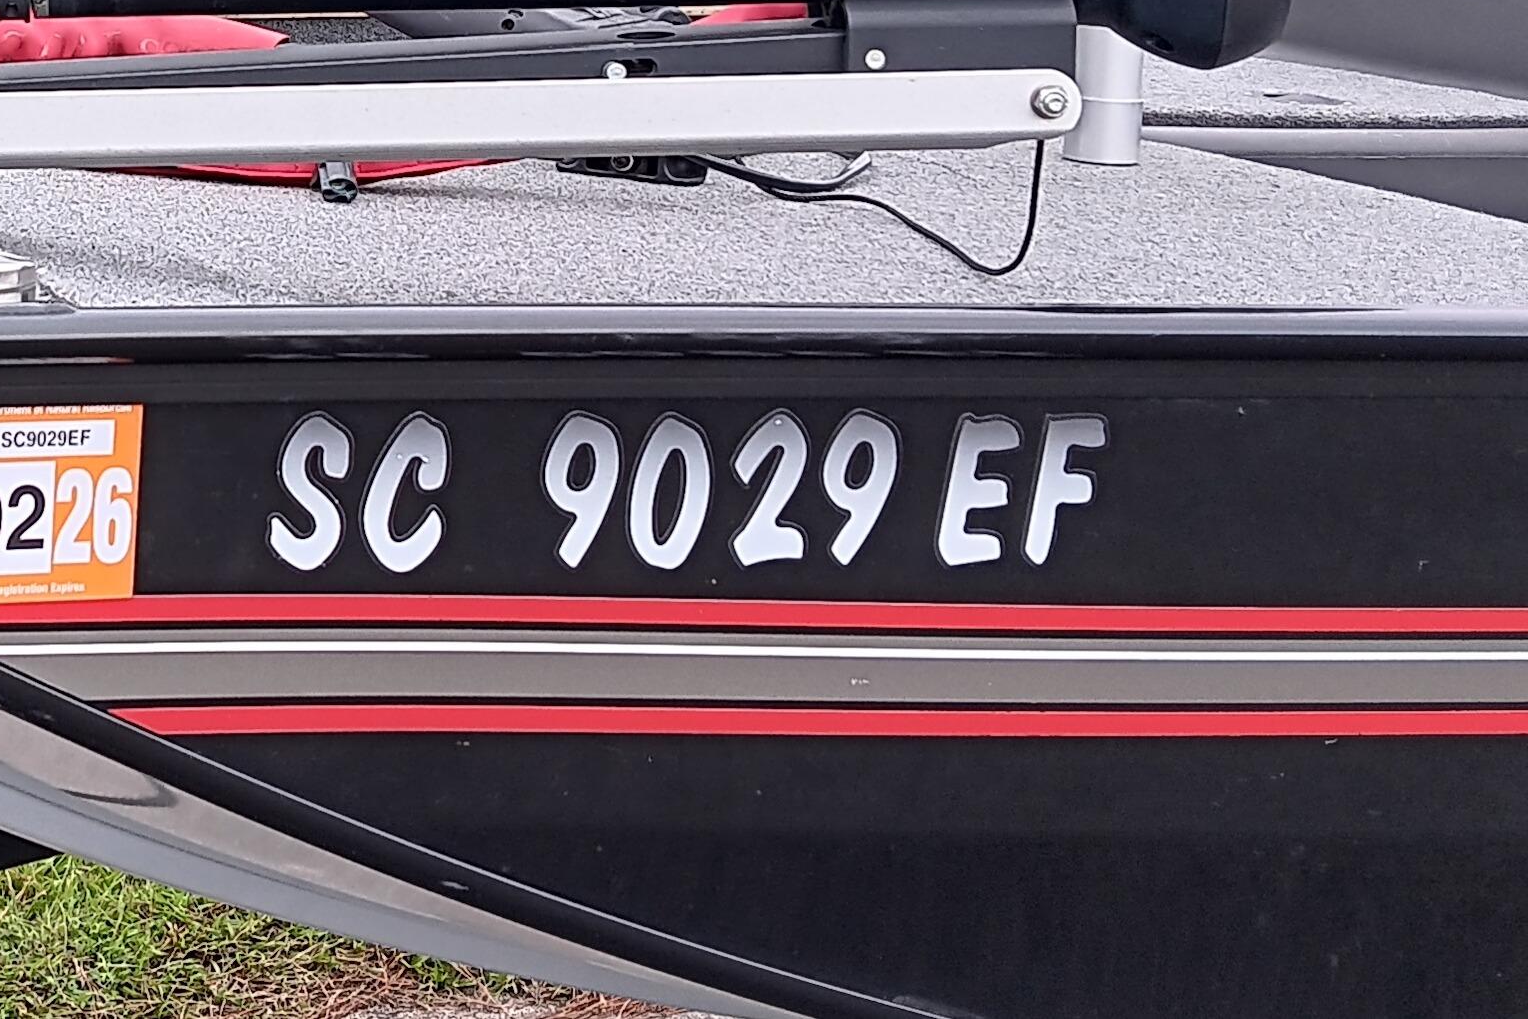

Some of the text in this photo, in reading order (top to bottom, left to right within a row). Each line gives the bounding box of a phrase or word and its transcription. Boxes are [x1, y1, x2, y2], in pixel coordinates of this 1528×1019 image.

[1, 429, 91, 449] SC9029EF
[52, 467, 133, 565] 26
[269, 410, 1108, 573] SC 9029 EF
[50, 582, 85, 595] Expires
